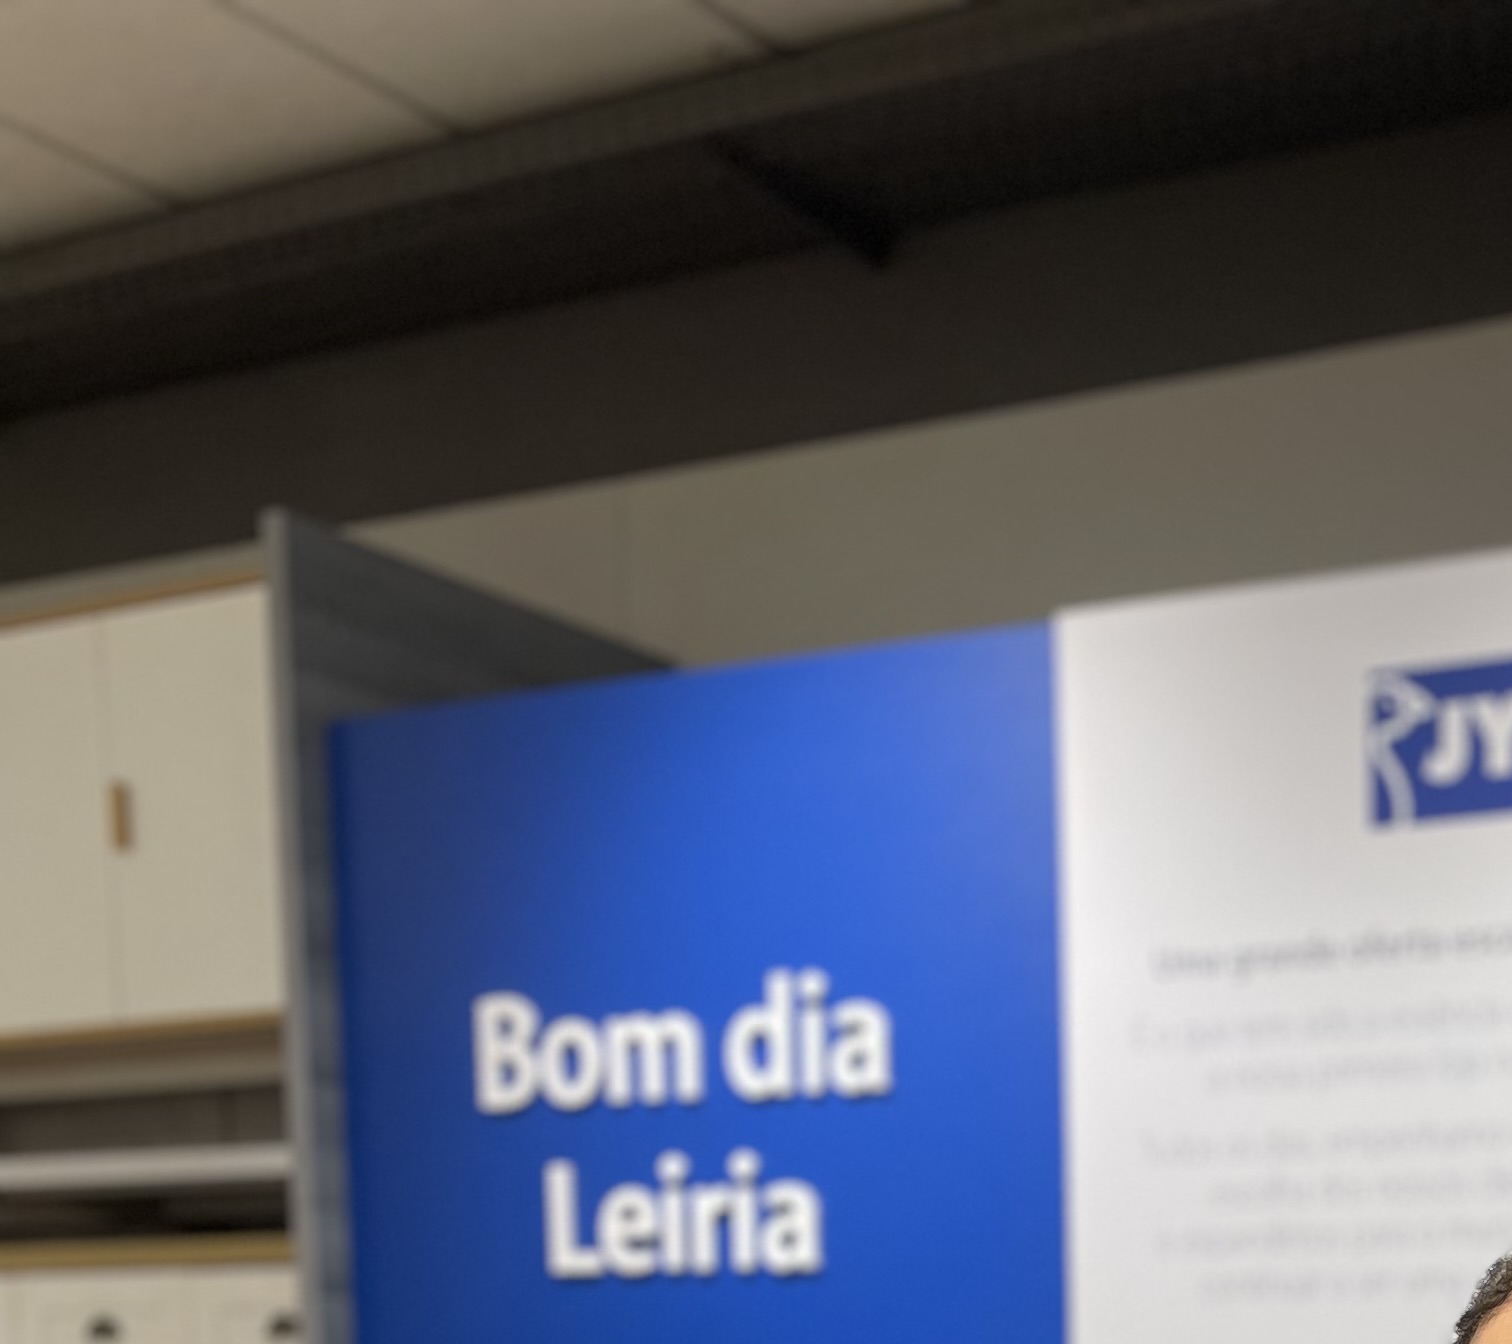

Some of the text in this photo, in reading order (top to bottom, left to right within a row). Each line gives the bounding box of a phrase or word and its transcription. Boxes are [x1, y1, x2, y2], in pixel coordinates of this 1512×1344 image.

[473, 964, 894, 1115] Bom dia
[542, 1143, 823, 1279] Leiria
